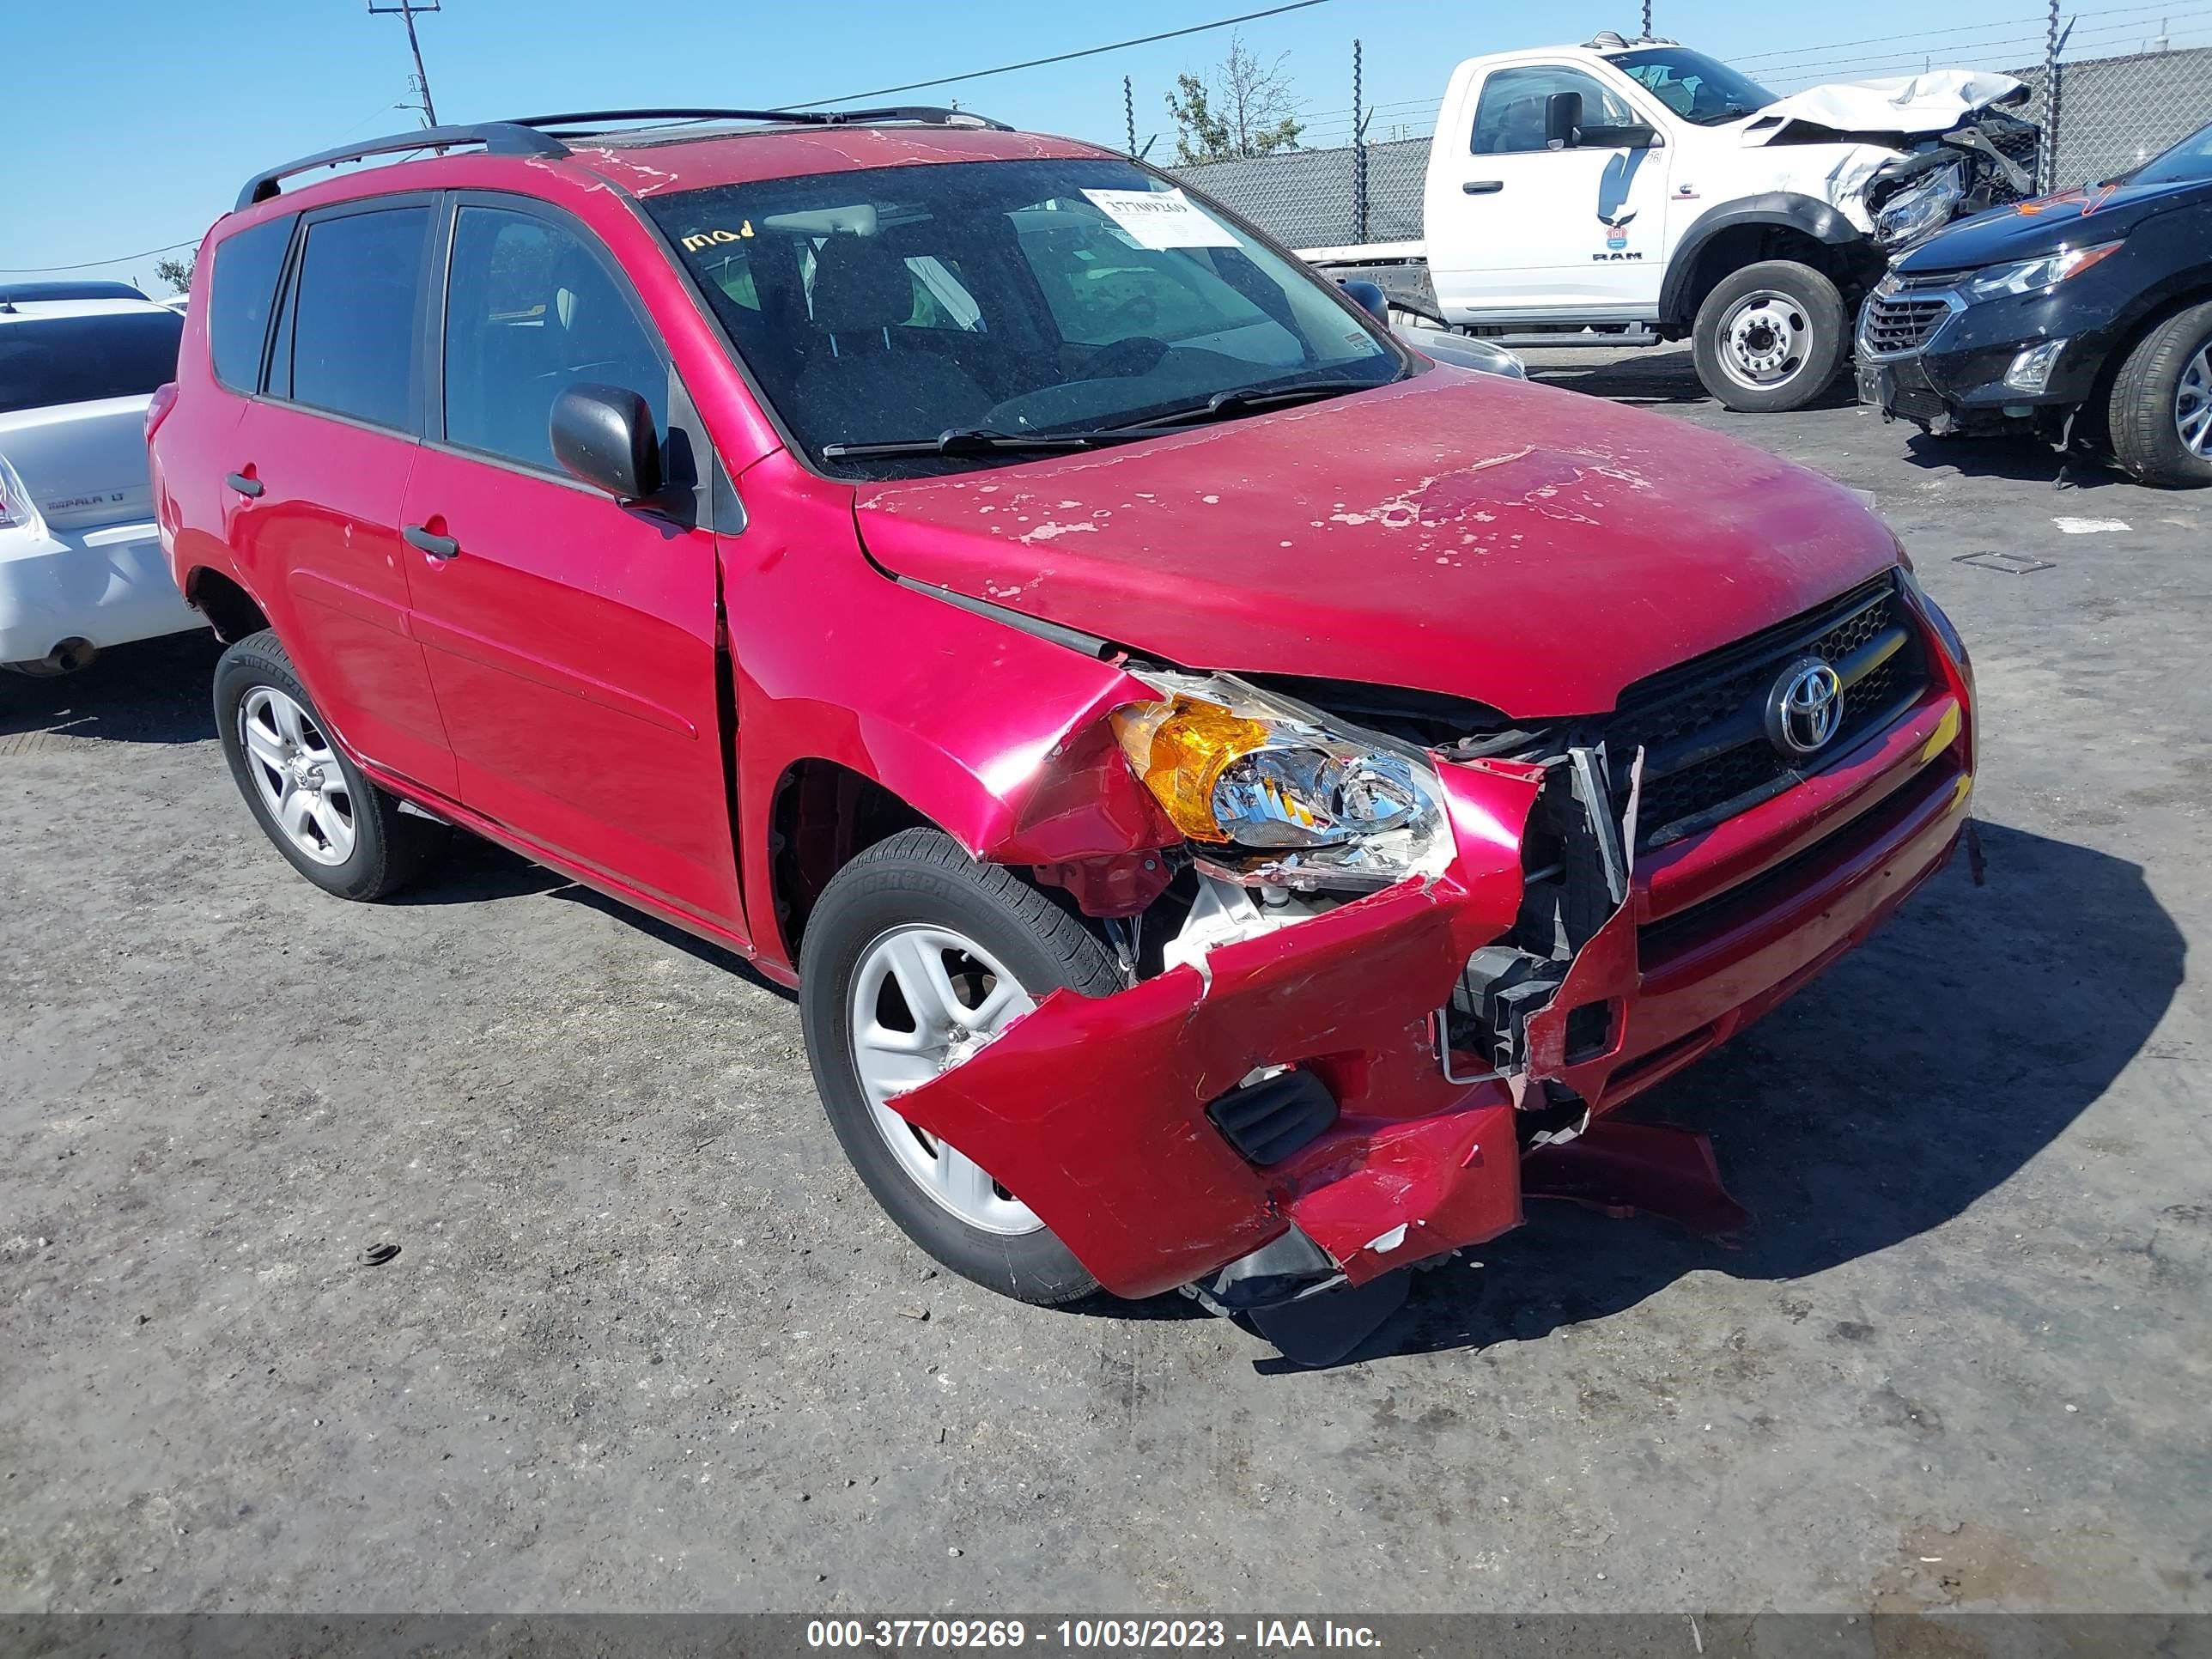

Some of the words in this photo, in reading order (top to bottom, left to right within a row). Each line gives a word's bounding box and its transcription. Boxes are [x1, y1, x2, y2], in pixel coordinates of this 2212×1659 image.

[1105, 201, 1188, 213] 37709269
[1593, 252, 1643, 261] RAM
[46, 495, 103, 510] IMPALA
[111, 493, 125, 502] LT
